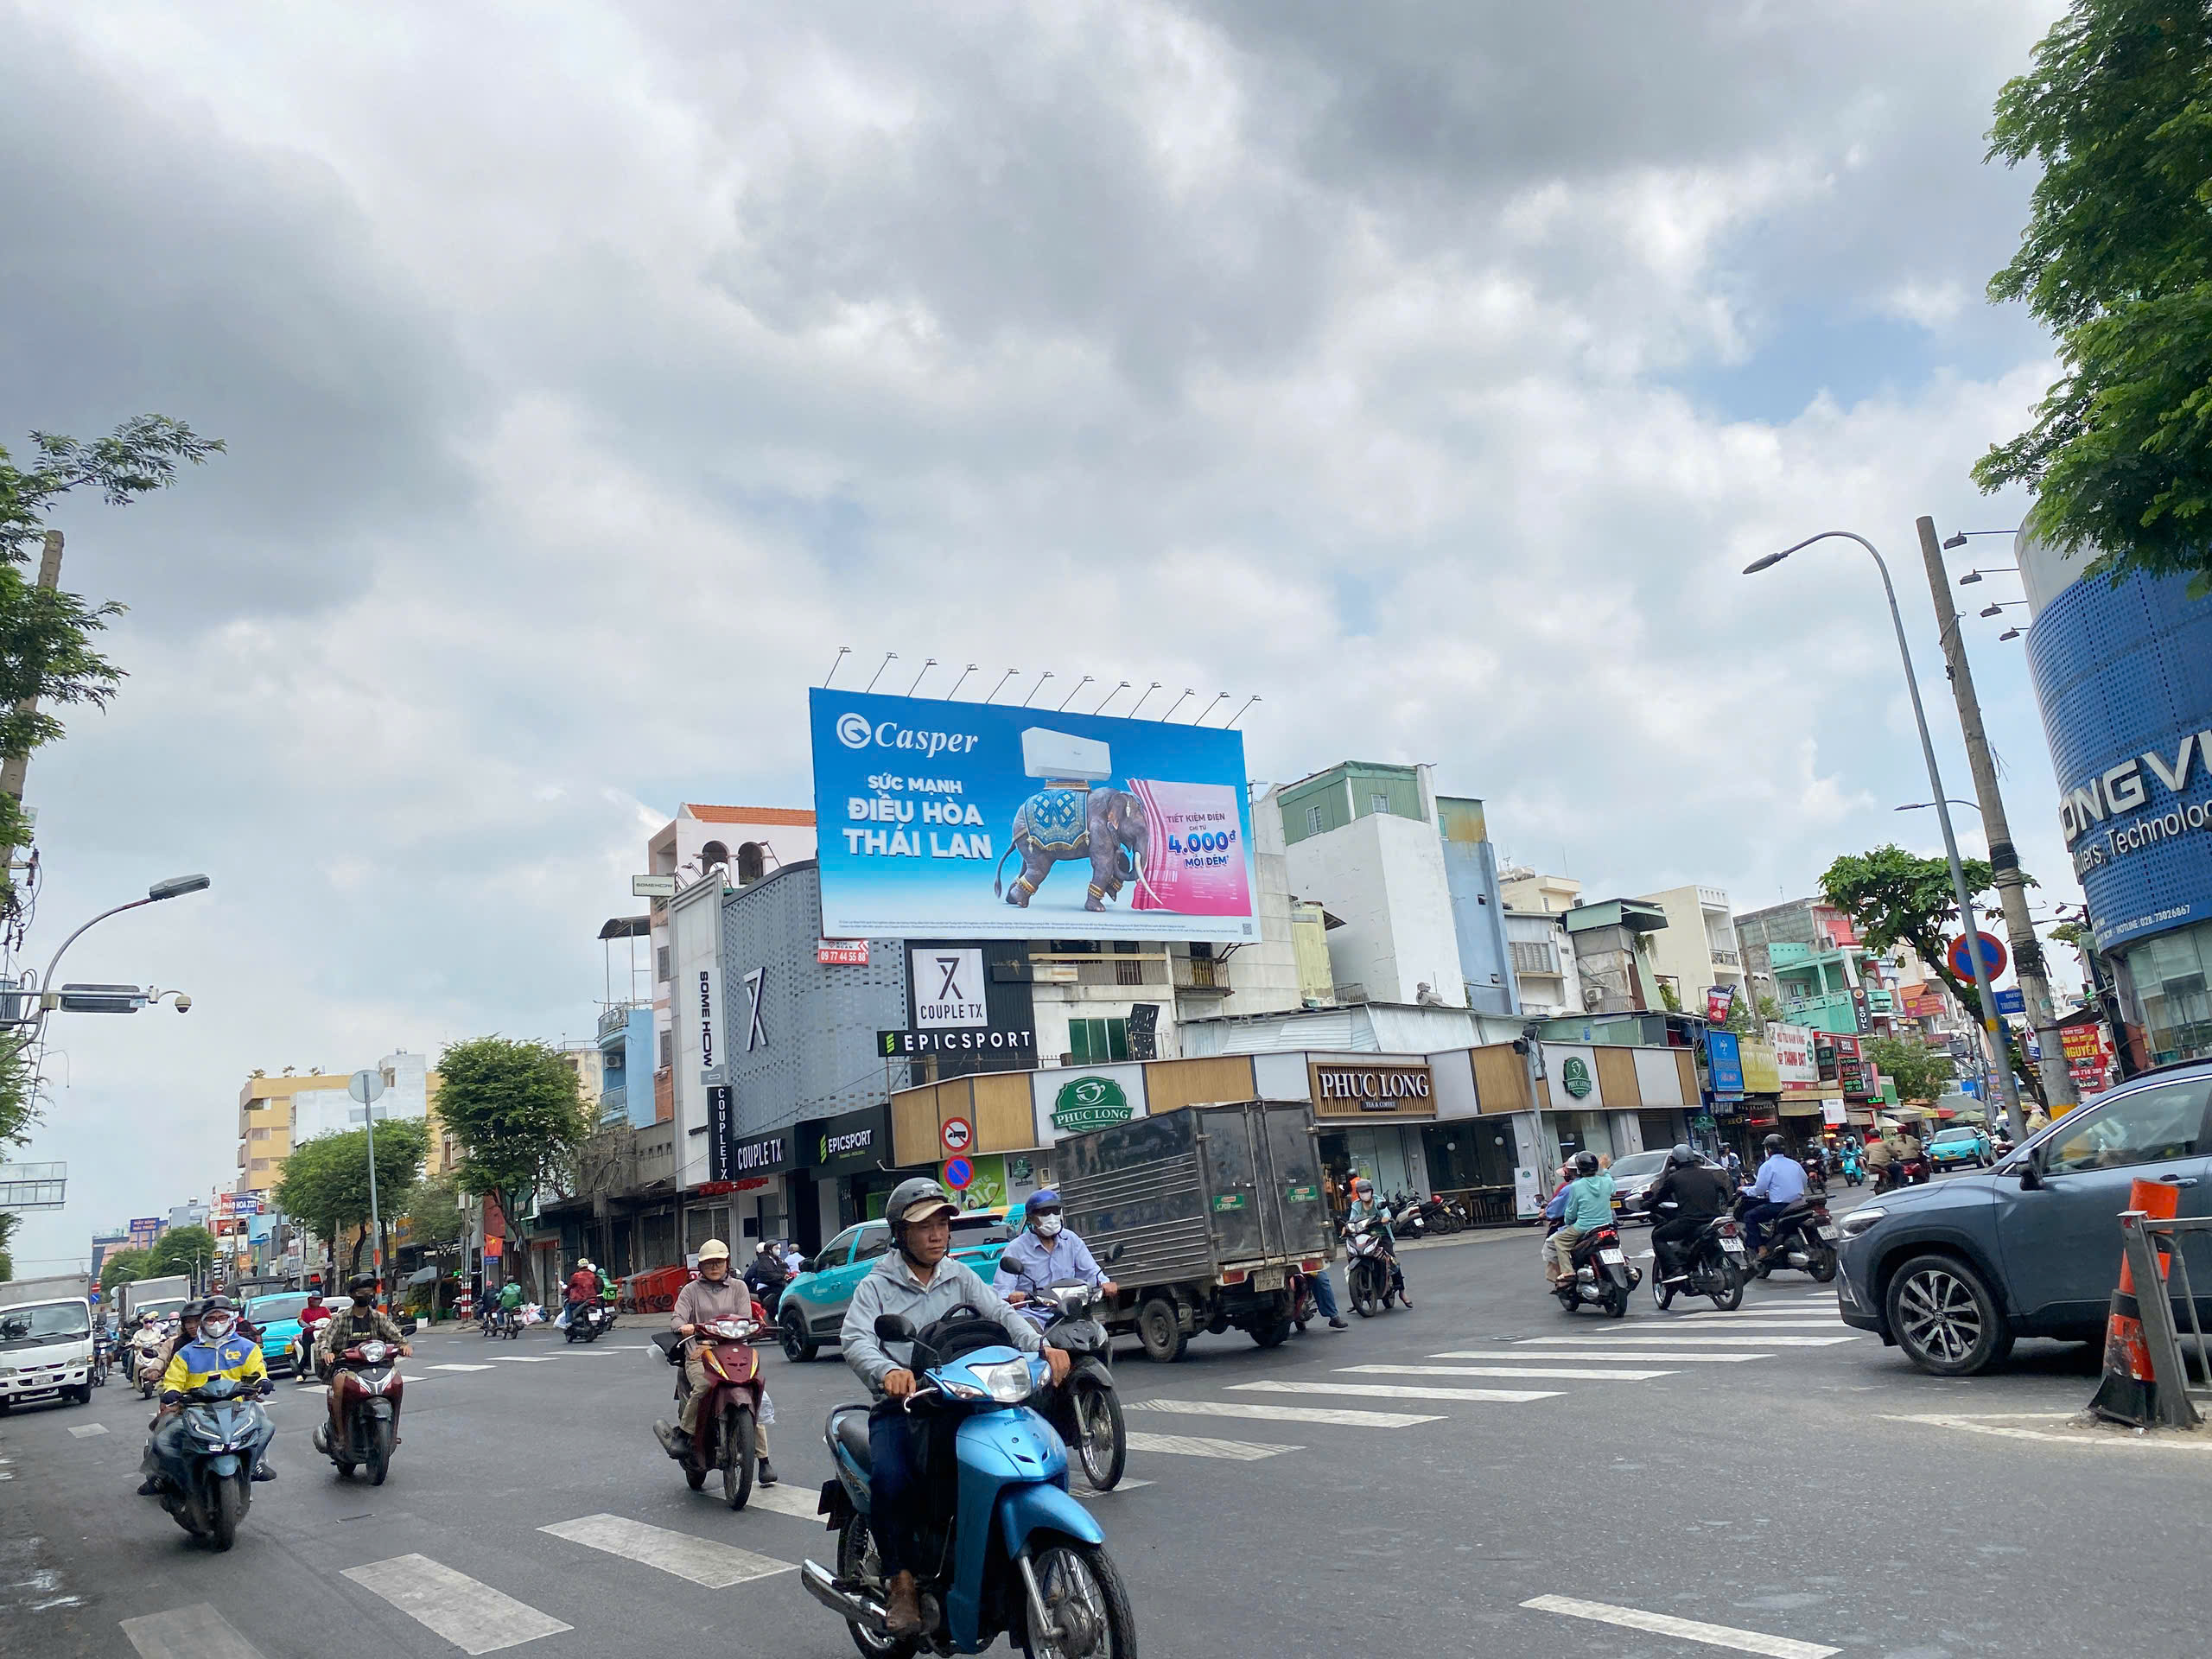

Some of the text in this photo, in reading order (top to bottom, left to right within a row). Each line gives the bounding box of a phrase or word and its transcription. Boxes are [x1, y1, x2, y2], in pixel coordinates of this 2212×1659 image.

[875, 721, 978, 758] Casper
[868, 772, 963, 795] SỨC MẠNH
[848, 790, 984, 826] ĐIỀU HÒA
[842, 823, 993, 860] THÁI LAN
[822, 951, 867, 962] 09 77 44 55 88
[700, 971, 712, 1067] SOME HOW
[920, 1003, 983, 1020] COUPLE TX
[904, 1032, 1030, 1051] EPICSPORT
[1319, 1073, 1429, 1098] PHUC LONG
[1057, 1109, 1129, 1124] PHUC LONG
[828, 1129, 872, 1153] EPICSPORT
[738, 1138, 783, 1170] COUPLE TX
